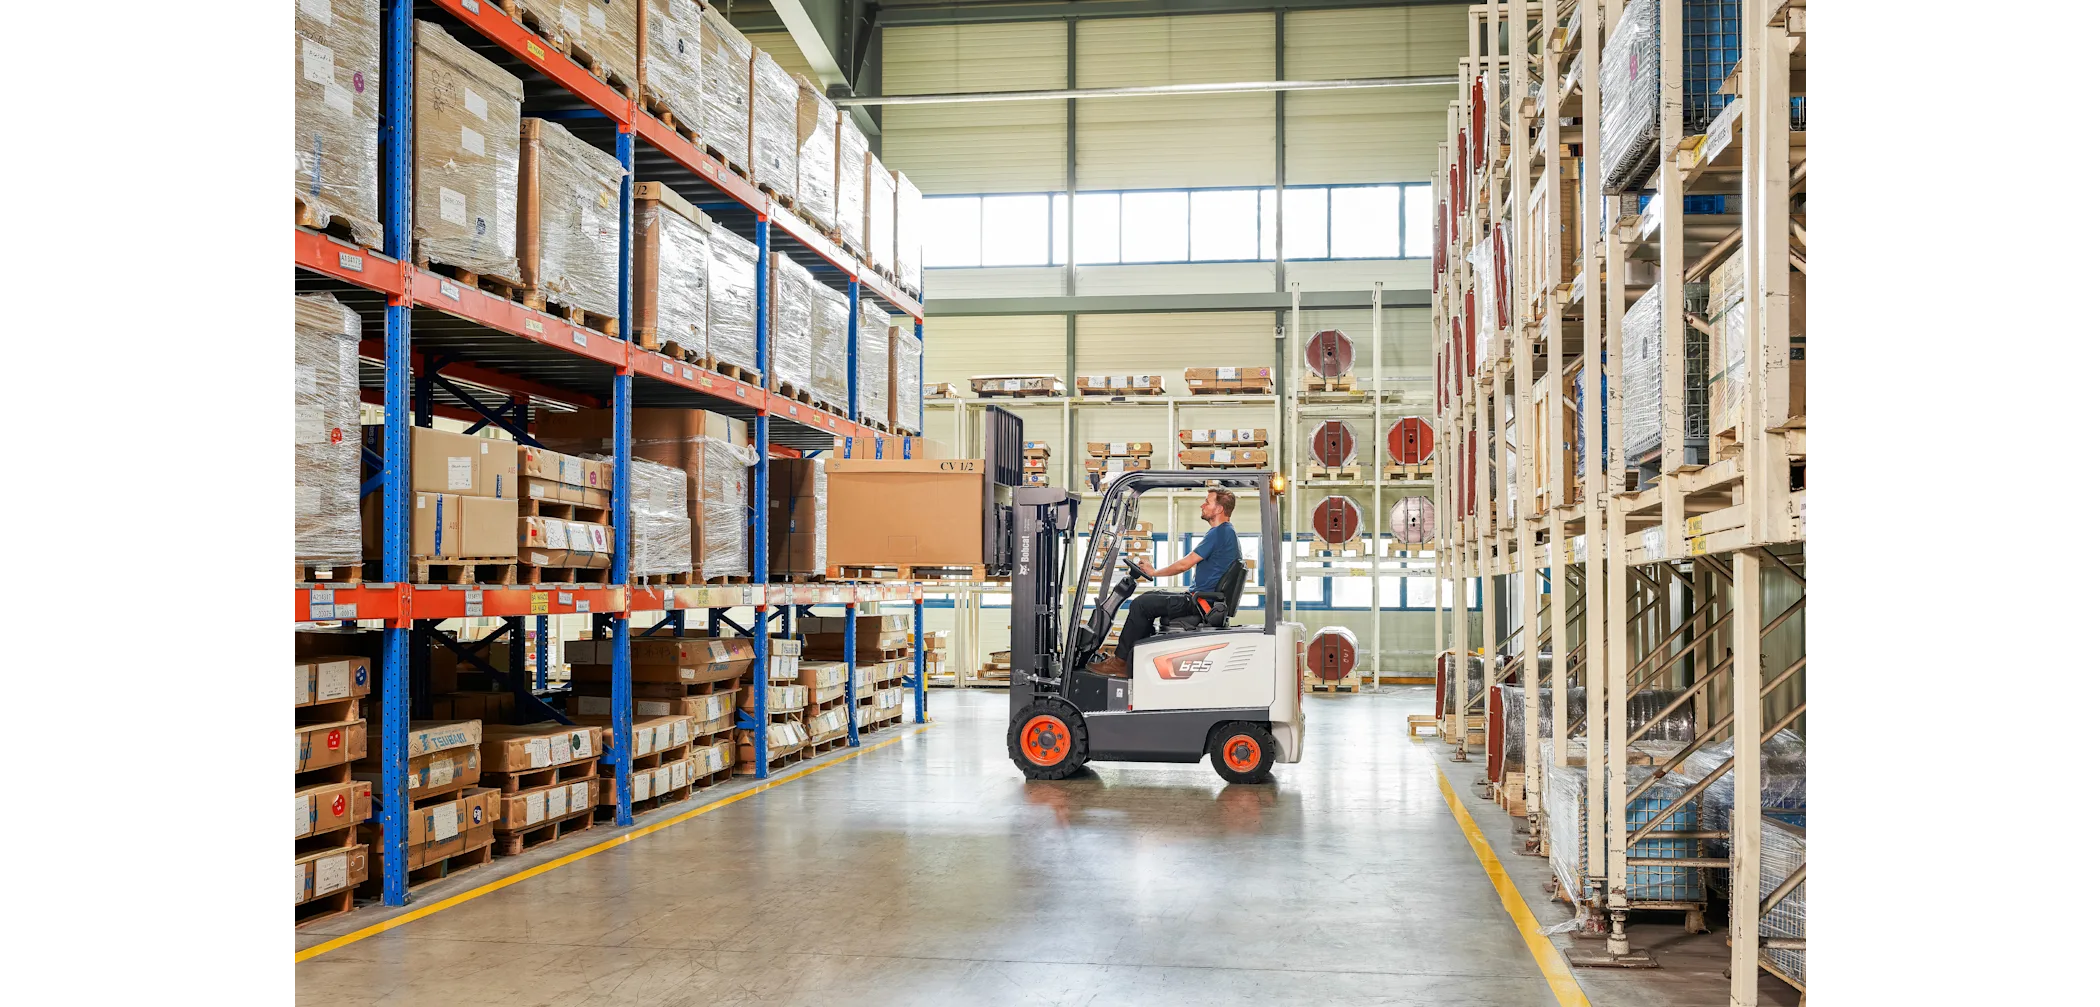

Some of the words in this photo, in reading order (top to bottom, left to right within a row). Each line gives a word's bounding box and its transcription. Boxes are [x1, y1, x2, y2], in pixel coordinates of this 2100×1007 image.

[940, 461, 956, 471] CV
[961, 461, 974, 471] 1/2
[1020, 535, 1030, 563] Bobcat
[431, 732, 467, 750] TSUBAKI
